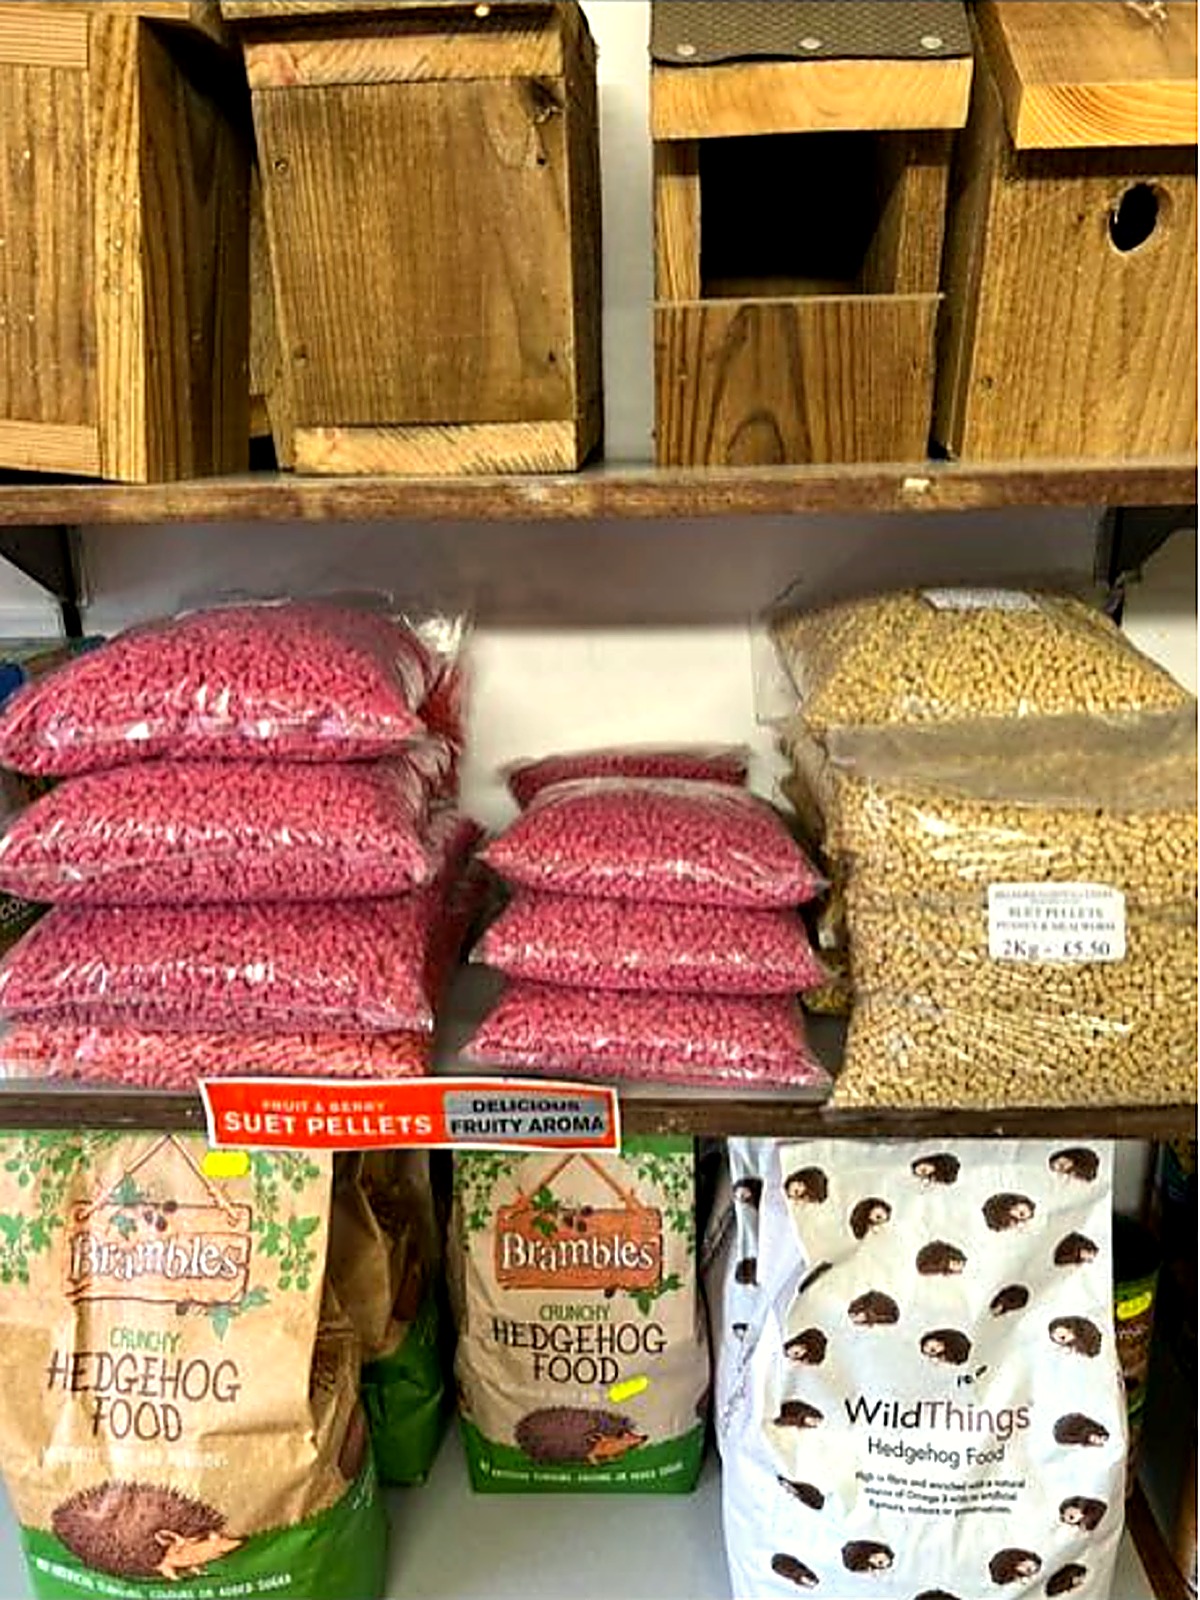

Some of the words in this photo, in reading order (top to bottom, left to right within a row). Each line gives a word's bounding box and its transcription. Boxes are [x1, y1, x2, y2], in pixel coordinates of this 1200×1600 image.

[261, 1100, 309, 1113] FRUIT
[473, 1099, 580, 1113] DELICIOUS
[224, 1111, 296, 1135] SUET
[306, 1114, 432, 1136] PELLETS
[451, 1118, 522, 1134] FRUITY
[528, 1115, 604, 1133] AROMA
[71, 1232, 242, 1282] Brambles
[502, 1231, 655, 1272] Brambles
[538, 1304, 612, 1322] CRUNCHY
[109, 1326, 182, 1354] CRUNCHY
[491, 1317, 668, 1355] HEDGEHOG
[46, 1349, 242, 1403] HEDGEHOG
[532, 1353, 620, 1384] FOOD
[91, 1399, 183, 1442] FOOD
[844, 1395, 1031, 1441] WildThings
[867, 1436, 961, 1469] Hedgehog
[966, 1444, 1006, 1467] Food
